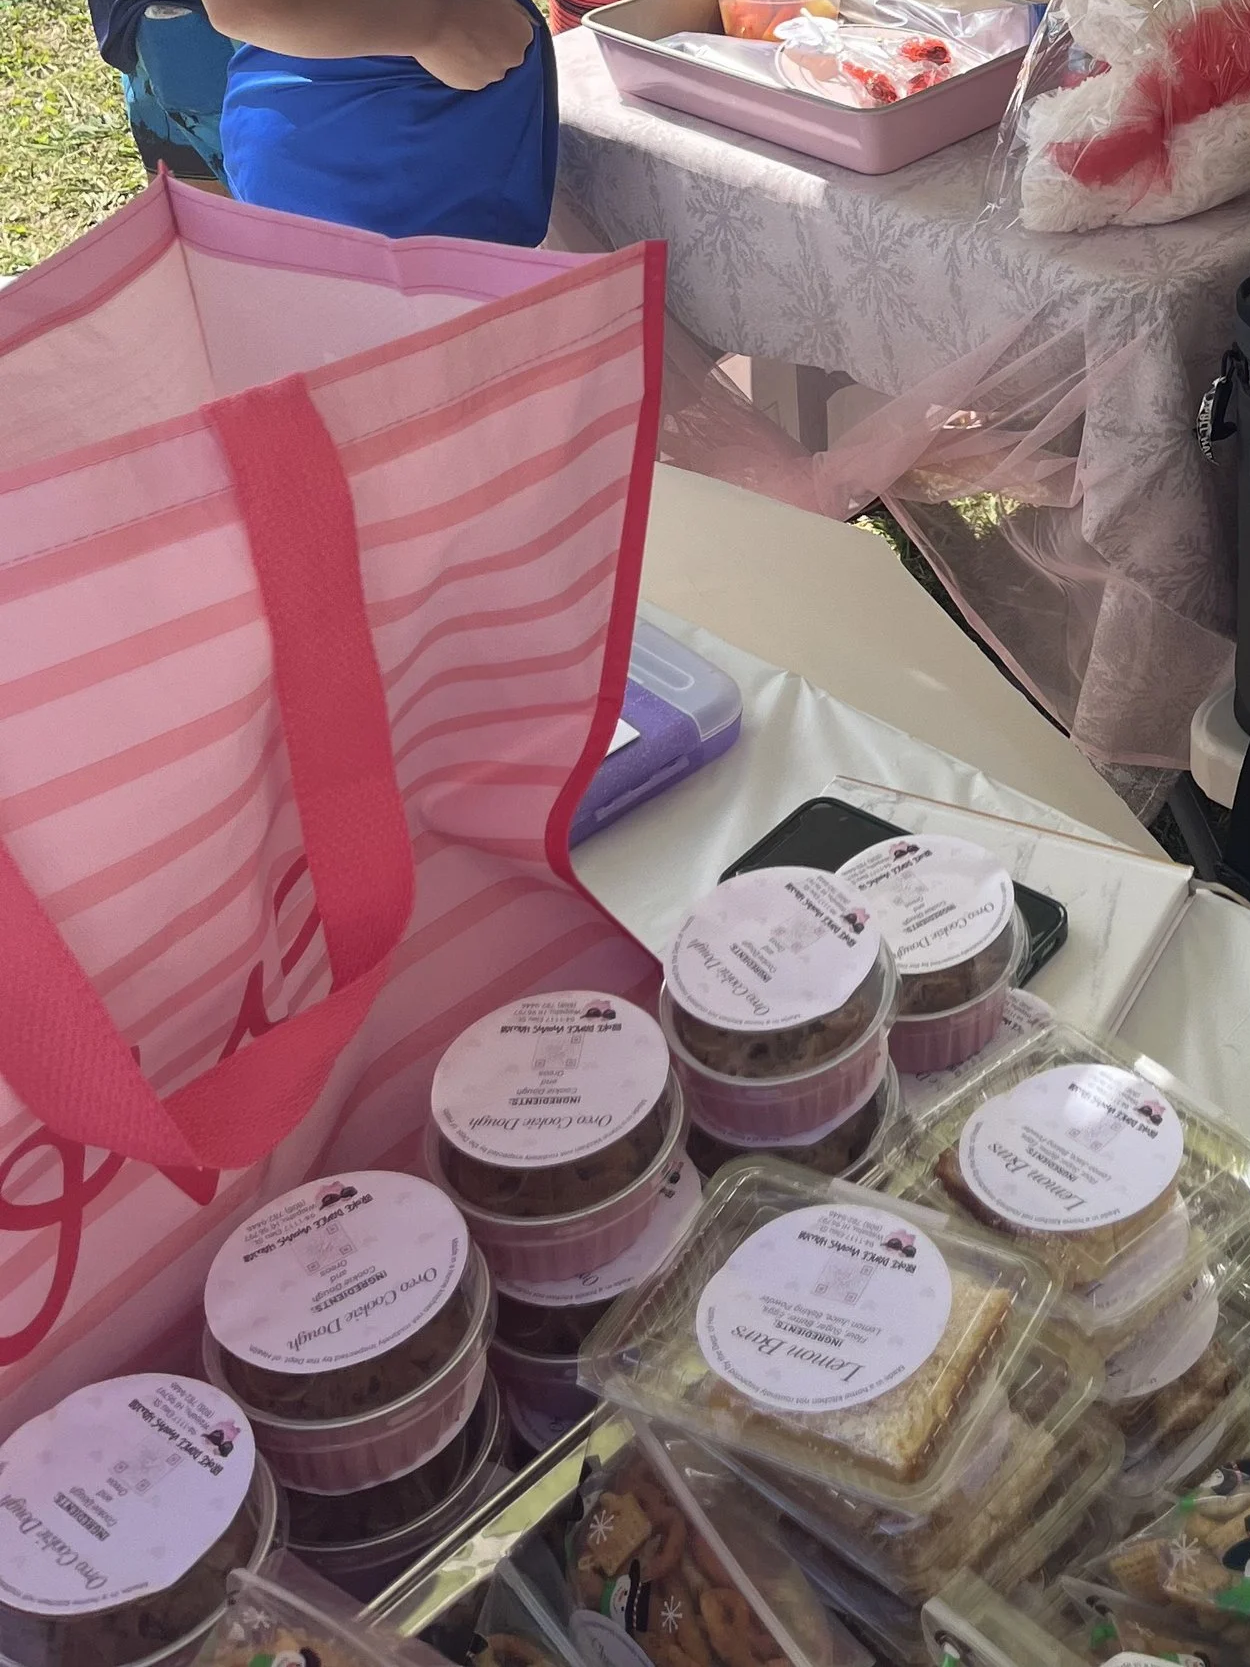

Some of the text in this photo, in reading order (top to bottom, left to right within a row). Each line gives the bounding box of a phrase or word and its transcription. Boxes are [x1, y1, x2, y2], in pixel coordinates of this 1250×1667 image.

[932, 918, 967, 940] Cookie
[686, 938, 722, 970] Dough
[716, 968, 749, 996] Cookie
[510, 1096, 581, 1106] INGREDIENTS:
[516, 1087, 578, 1096] Cookie Dough
[469, 1115, 613, 1131] Oreo Cookie Dough
[988, 1143, 1086, 1211] Lemon Bars
[320, 1259, 348, 1277] Oreos
[330, 1269, 347, 1284] and
[311, 1270, 387, 1312] INGREDIENTS:
[312, 1265, 376, 1303] Cookie Dough
[288, 1267, 437, 1352] Oreo Cookie Dough
[759, 1295, 793, 1311] Powder
[793, 1304, 824, 1320] Baking
[775, 1320, 843, 1347] INGREDIENTS:
[850, 1321, 882, 1336] Lemon
[731, 1326, 864, 1382] Lemon Bars
[727, 1365, 760, 1393] inspected
[759, 1388, 795, 1403] routinely
[812, 1394, 843, 1405] kitchen
[0, 1494, 108, 1590] Oreo Cookie Dough
